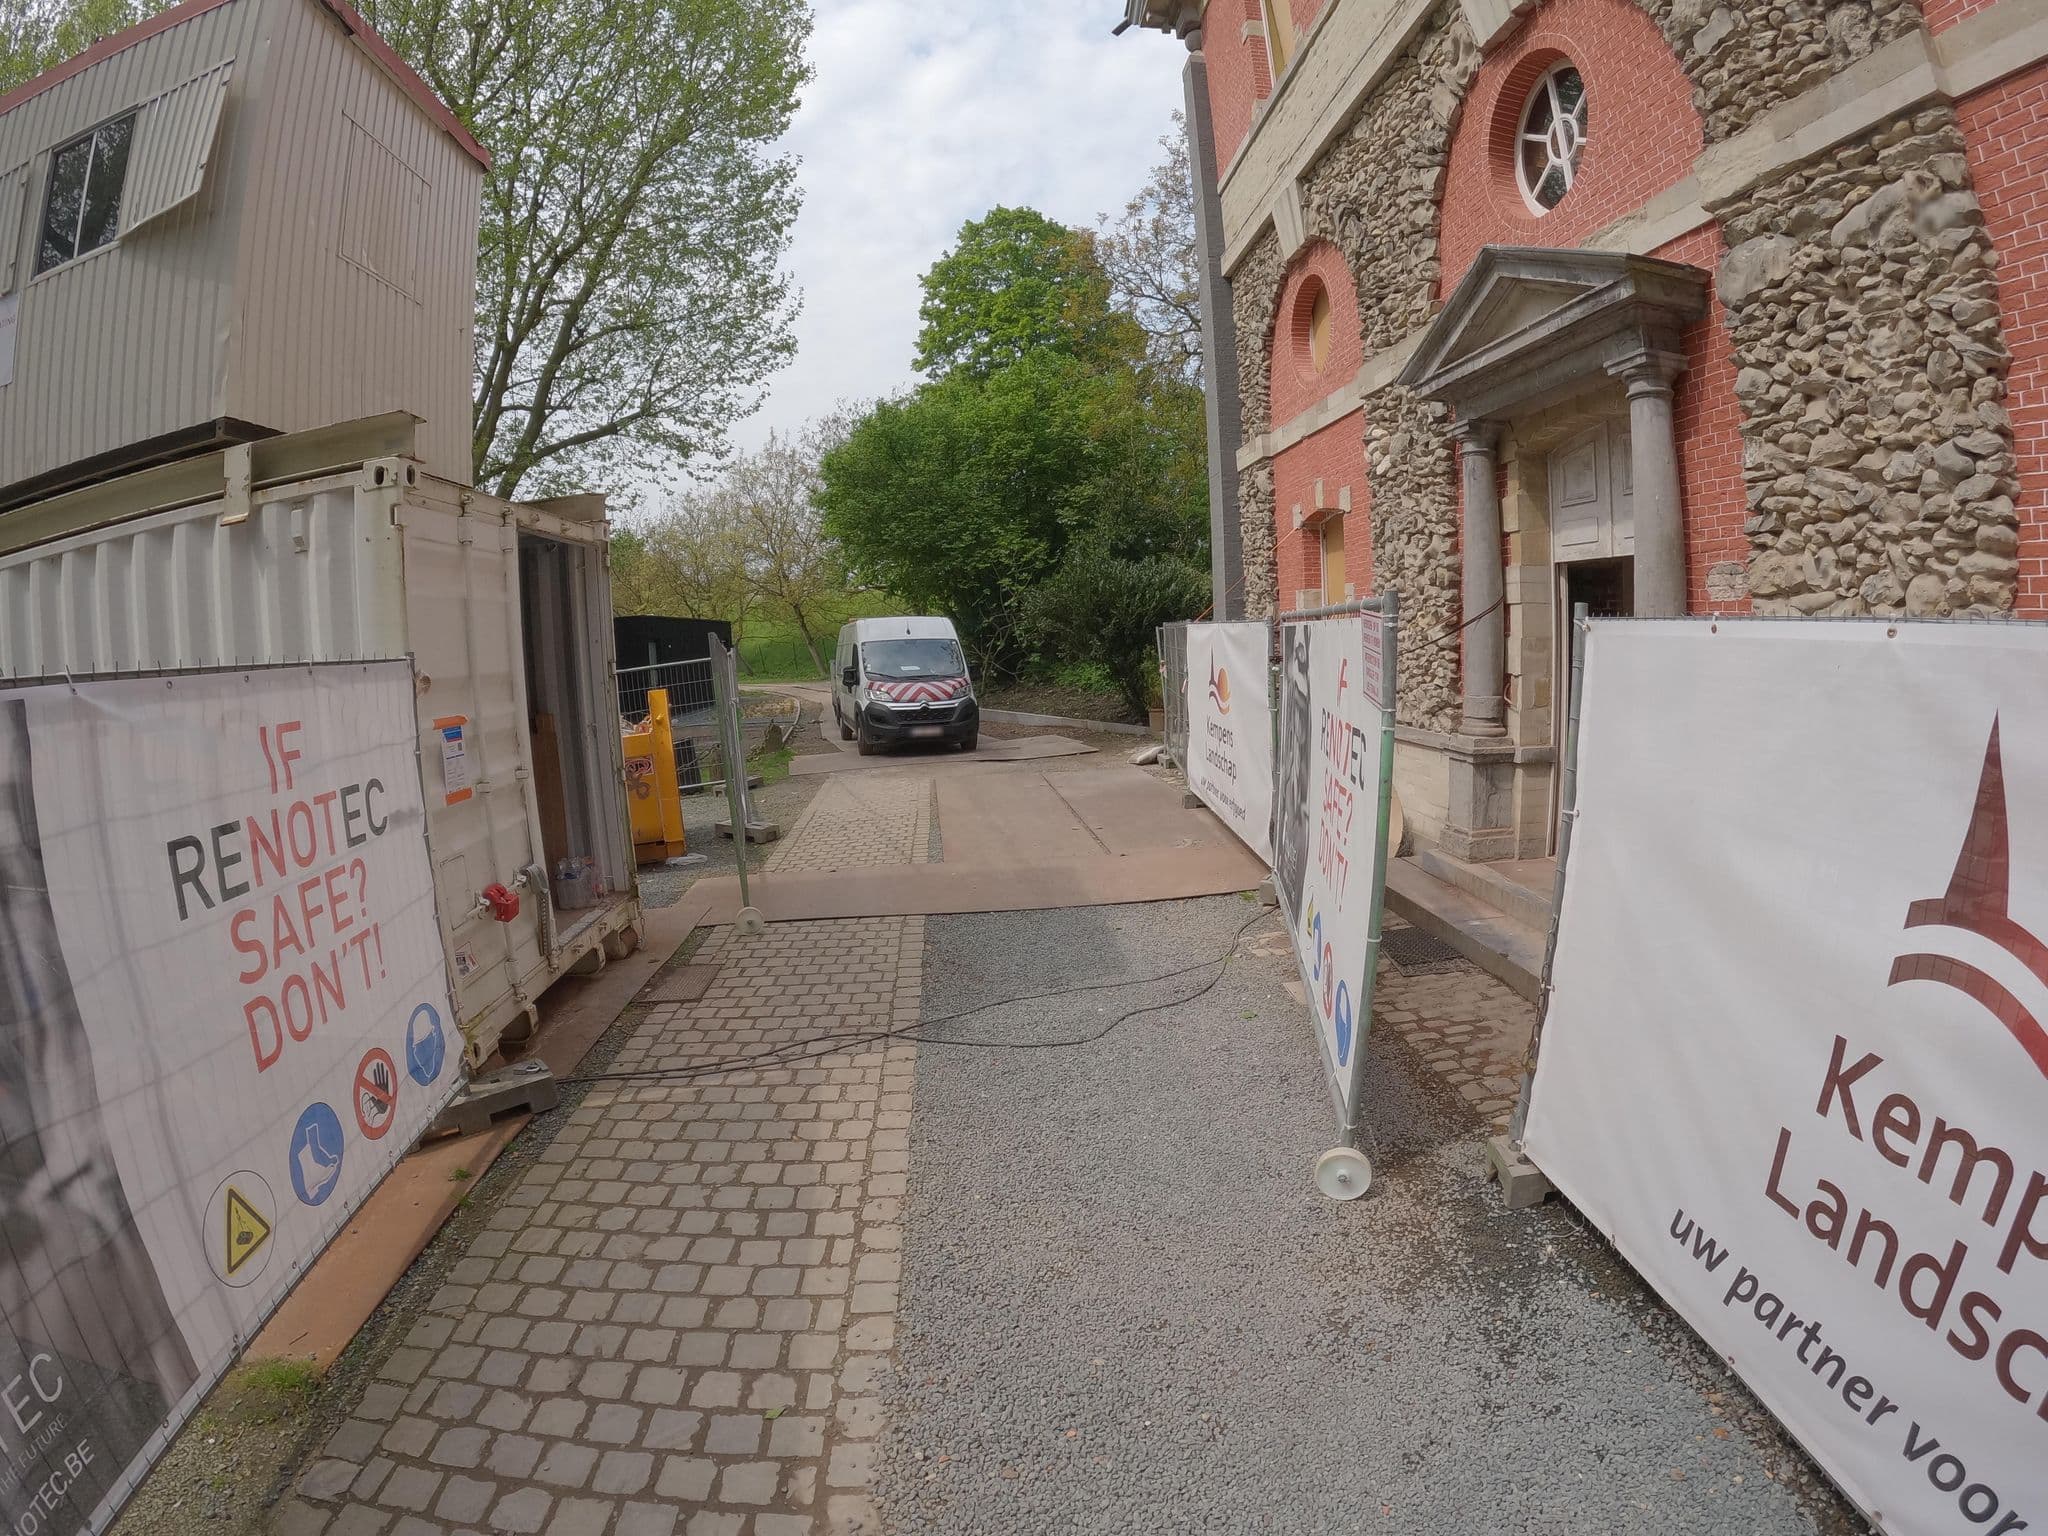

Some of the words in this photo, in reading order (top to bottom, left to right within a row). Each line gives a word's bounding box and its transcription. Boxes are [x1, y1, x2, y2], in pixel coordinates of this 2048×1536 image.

[259, 720, 302, 795] IF
[1205, 741, 1237, 786] Landschap
[1206, 715, 1233, 748] Kempens
[1320, 707, 1367, 792] RENOTEC
[166, 777, 388, 922] RENOTEC
[1323, 767, 1353, 846] SAFE?
[1318, 816, 1349, 913] DON'T!
[229, 857, 368, 985] SAFE?
[242, 922, 387, 1074] DON'T!
[1765, 1127, 2048, 1423] Landsc
[0, 1353, 63, 1454] EC
[1669, 1208, 1729, 1274] uw
[1723, 1265, 1900, 1427] partner
[1902, 1421, 2030, 1536] voor
[17, 1412, 69, 1469] FUTURE
